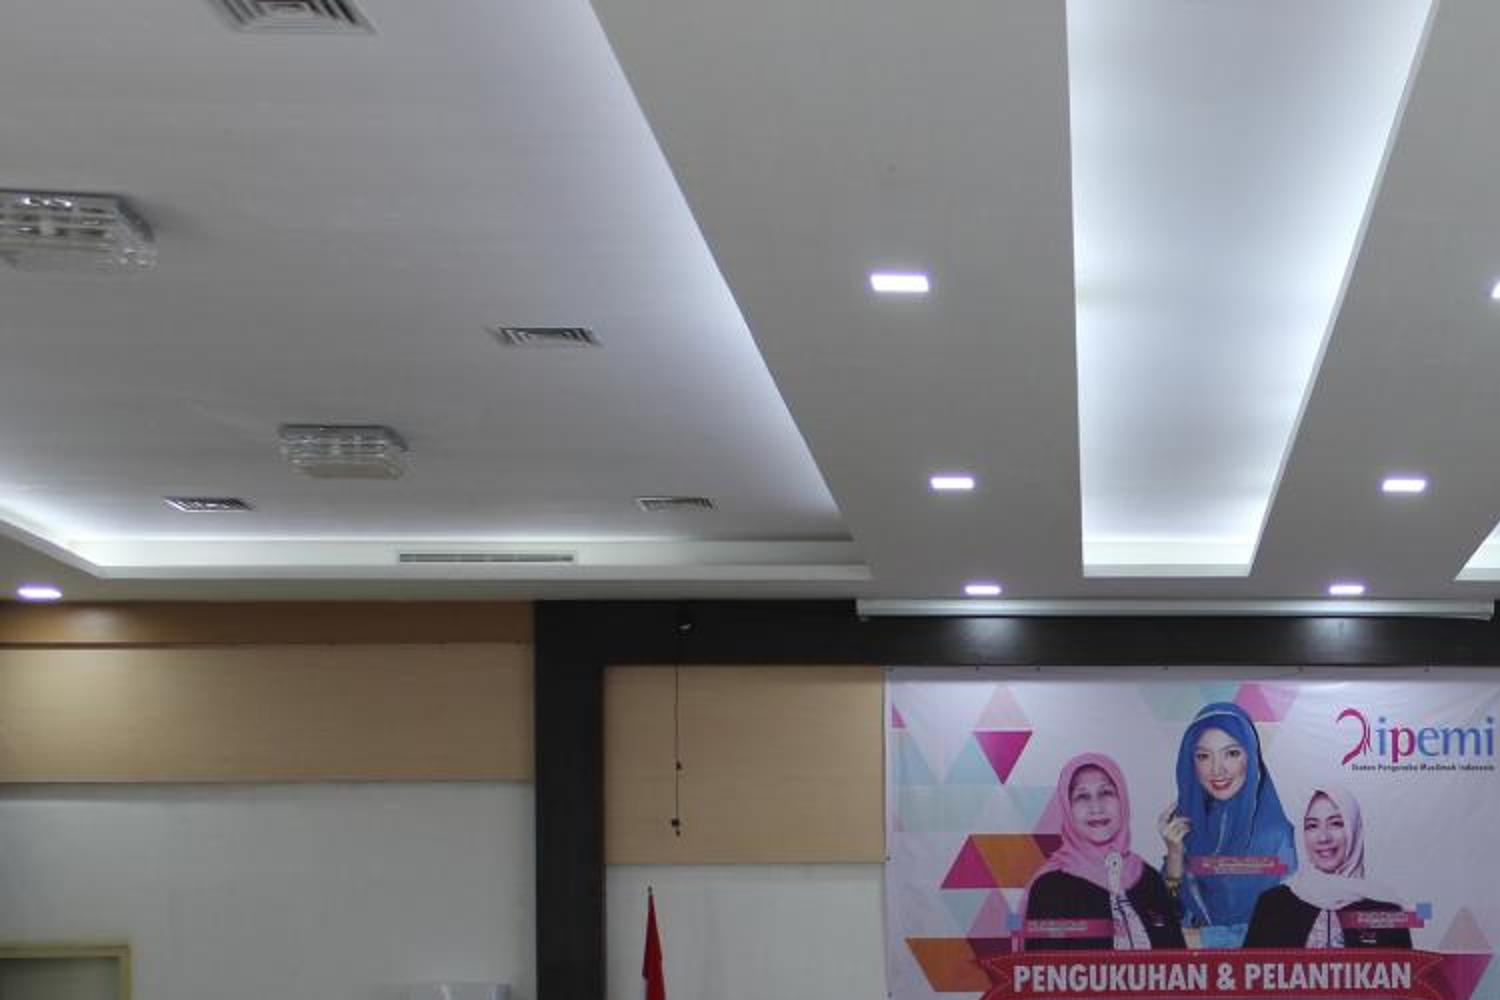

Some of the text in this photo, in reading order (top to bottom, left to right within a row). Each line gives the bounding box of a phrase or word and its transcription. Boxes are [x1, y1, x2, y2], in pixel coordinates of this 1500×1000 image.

[1375, 716, 1495, 763] ipemi
[1013, 961, 1412, 993] PENGUKUHAN & PELANTIKAN
